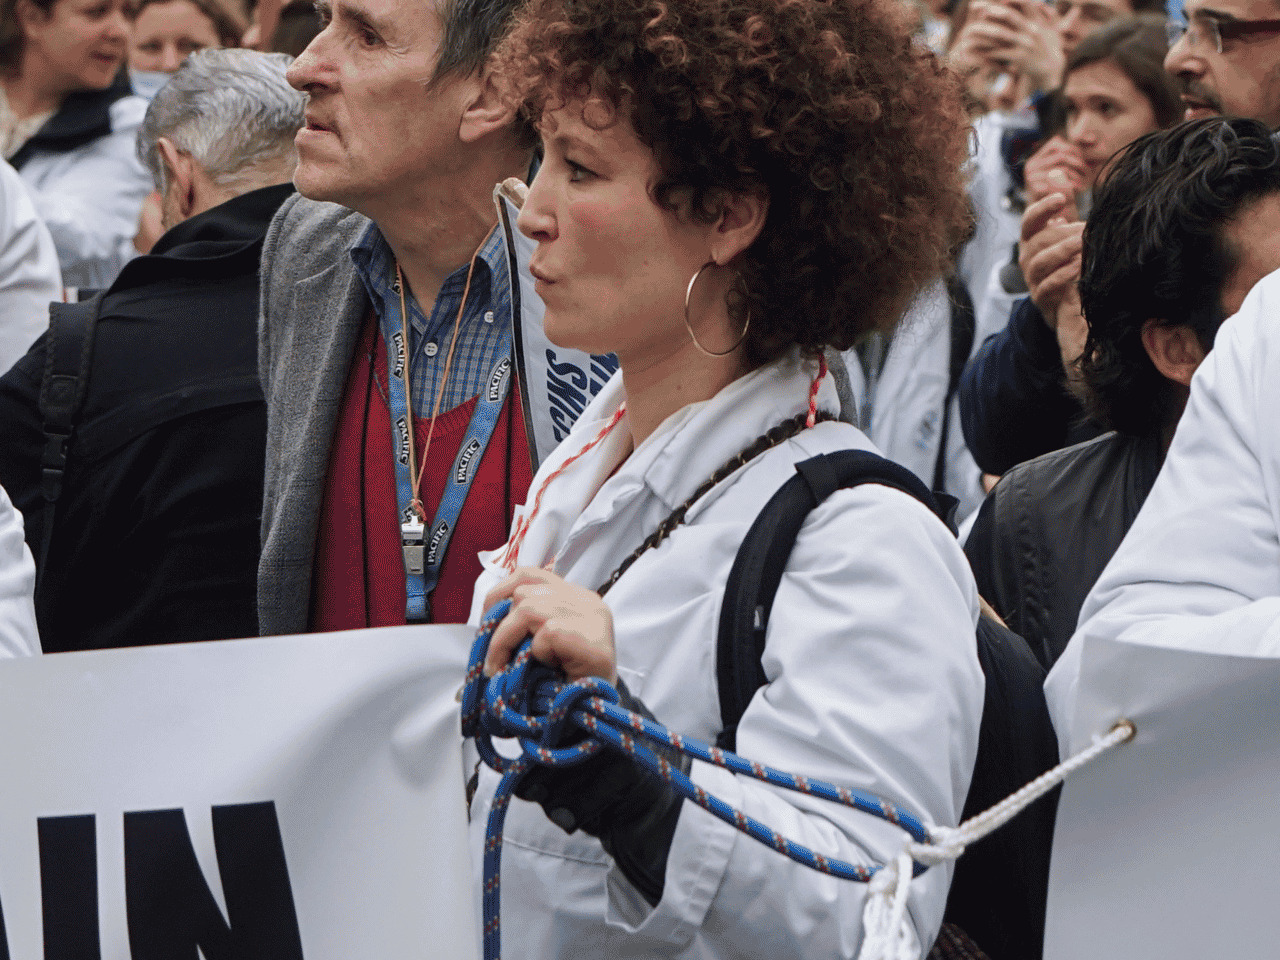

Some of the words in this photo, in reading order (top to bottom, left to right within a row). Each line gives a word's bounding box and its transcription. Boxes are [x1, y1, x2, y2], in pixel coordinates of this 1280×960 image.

[488, 357, 512, 402] PACIFIC
[457, 438, 481, 484] PACIFIC
[427, 521, 450, 565] PACIFIC
